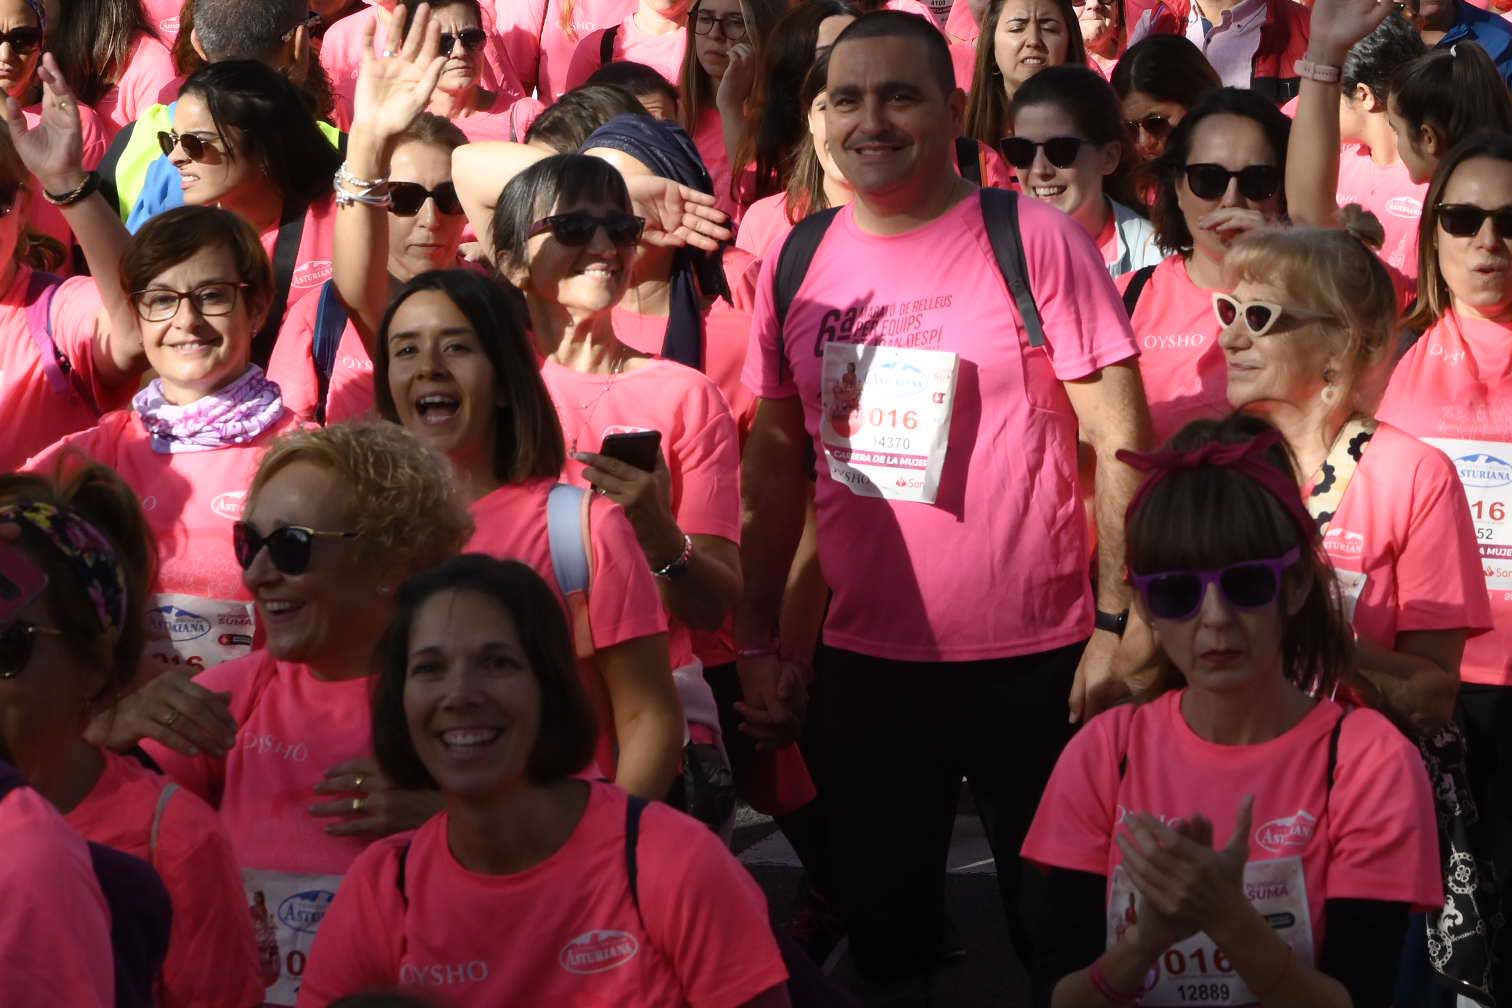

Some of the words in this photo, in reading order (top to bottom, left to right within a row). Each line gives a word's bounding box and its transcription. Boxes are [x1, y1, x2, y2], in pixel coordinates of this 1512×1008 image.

[913, 295, 953, 312] RELLEUS
[880, 313, 924, 337] EQUIPS
[1143, 333, 1204, 350] OYSHO
[869, 408, 918, 430] 016
[566, 940, 635, 966] ASTURIANA
[1163, 947, 1232, 975] 016
[400, 960, 489, 986] OYSHO
[1177, 983, 1230, 1001] 12889
